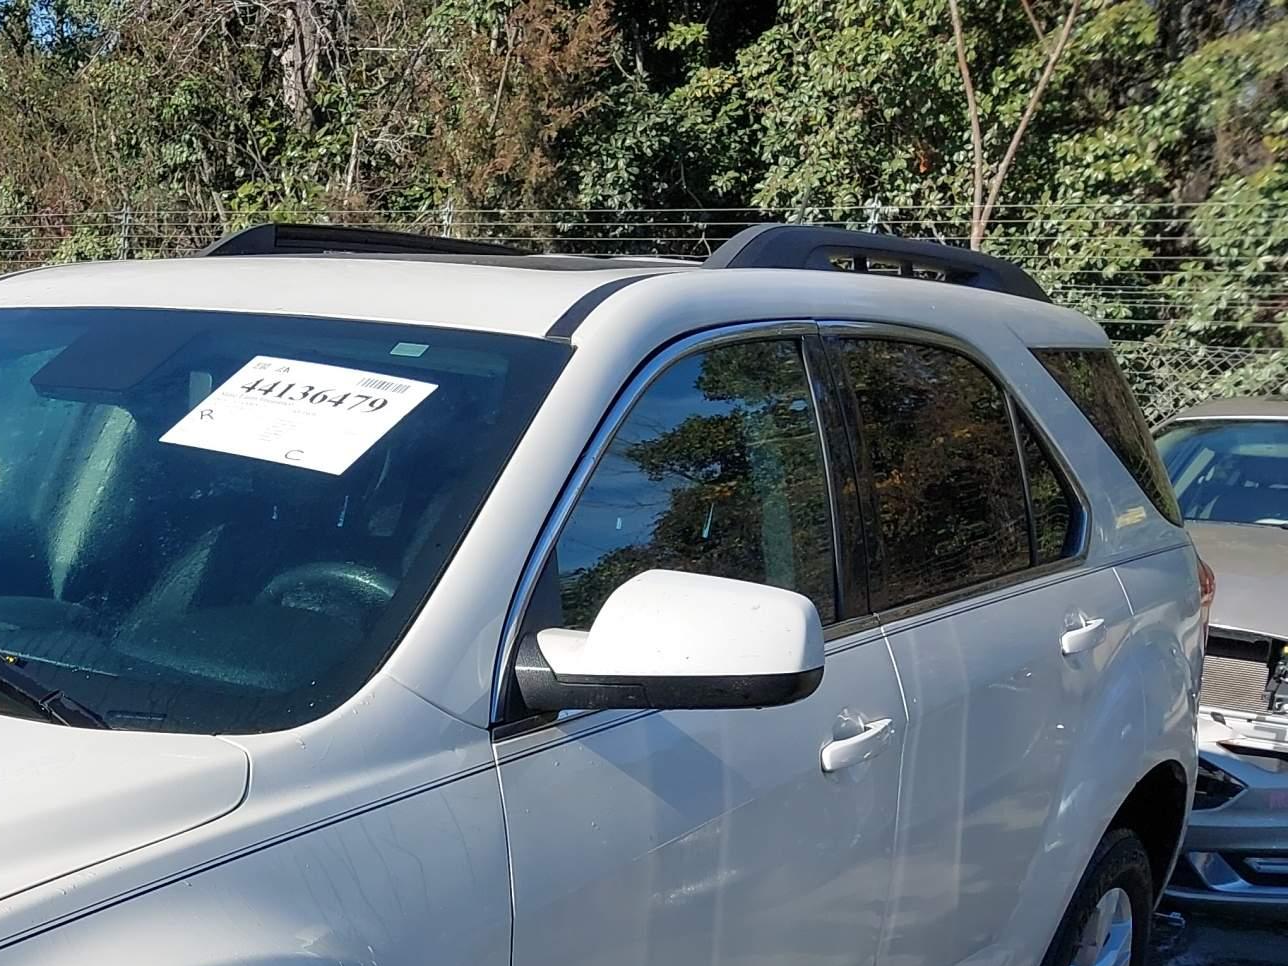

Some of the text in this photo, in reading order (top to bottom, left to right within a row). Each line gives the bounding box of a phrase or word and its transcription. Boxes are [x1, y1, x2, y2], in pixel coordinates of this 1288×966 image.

[239, 377, 389, 414] 44136479
[199, 408, 215, 421] R
[283, 448, 305, 462] C
